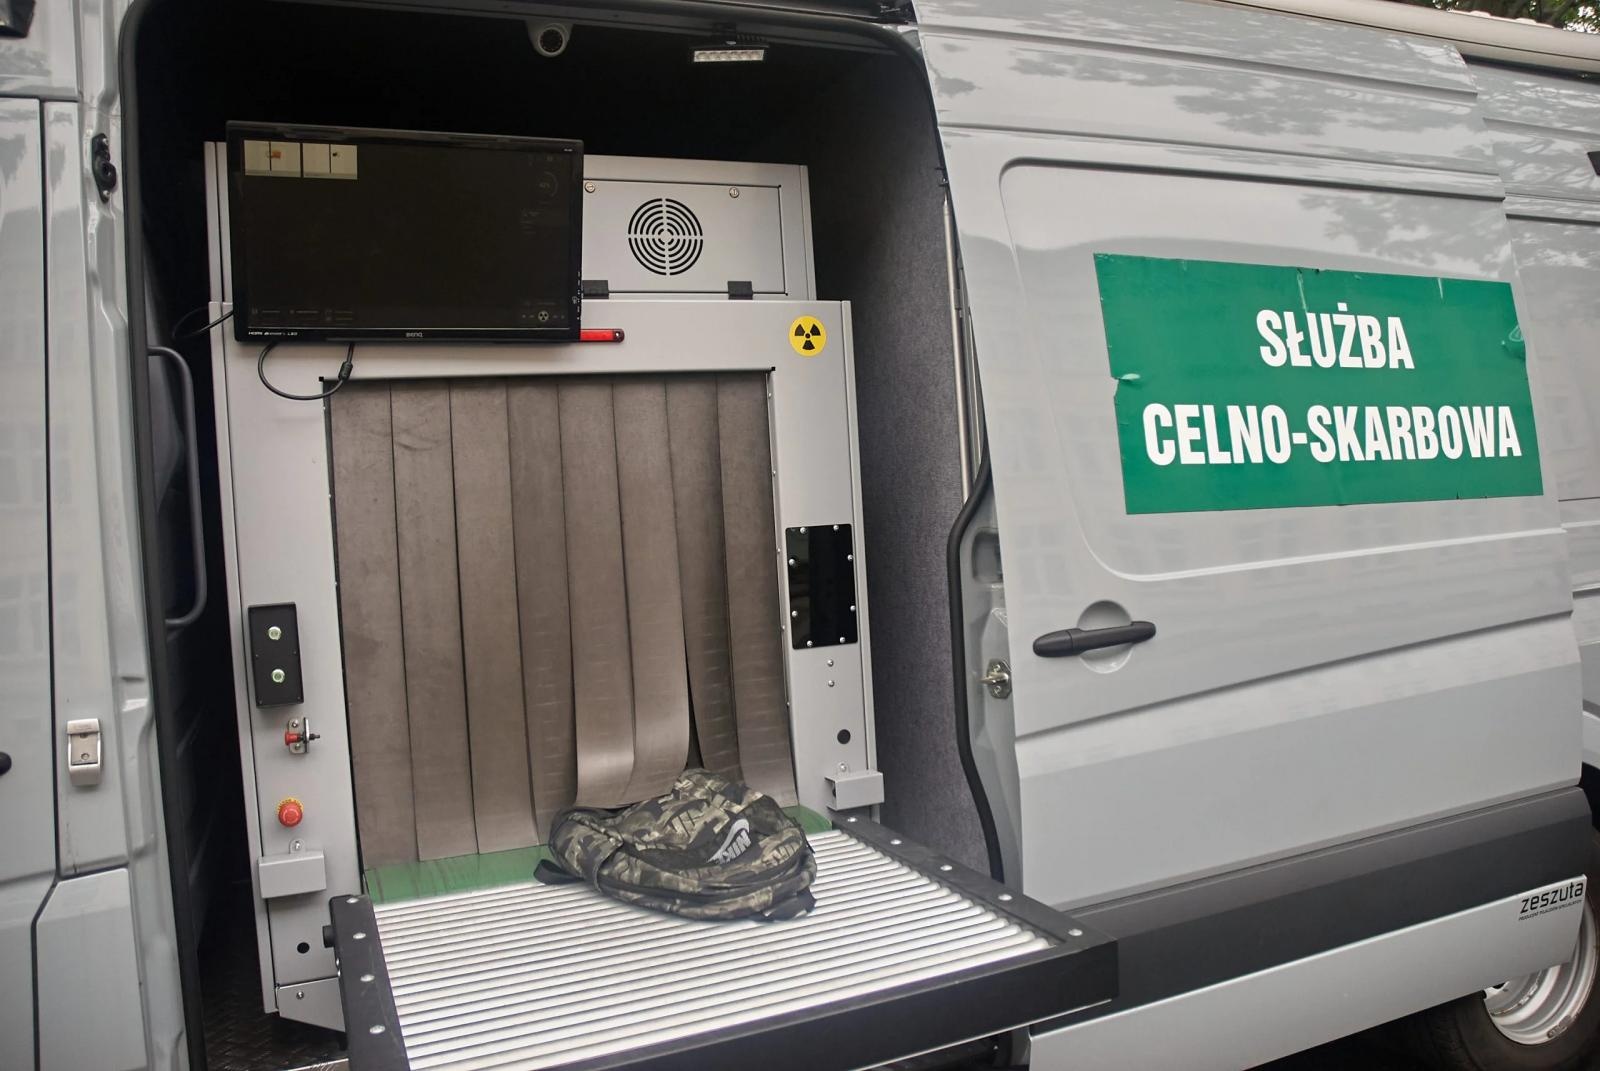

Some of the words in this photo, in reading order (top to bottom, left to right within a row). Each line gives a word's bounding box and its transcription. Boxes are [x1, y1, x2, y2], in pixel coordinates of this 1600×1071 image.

[1256, 302, 1415, 369] SŁUŻBA
[1142, 402, 1522, 466] CELNO-SKARBOWA
[1520, 881, 1584, 914] zeszuta
